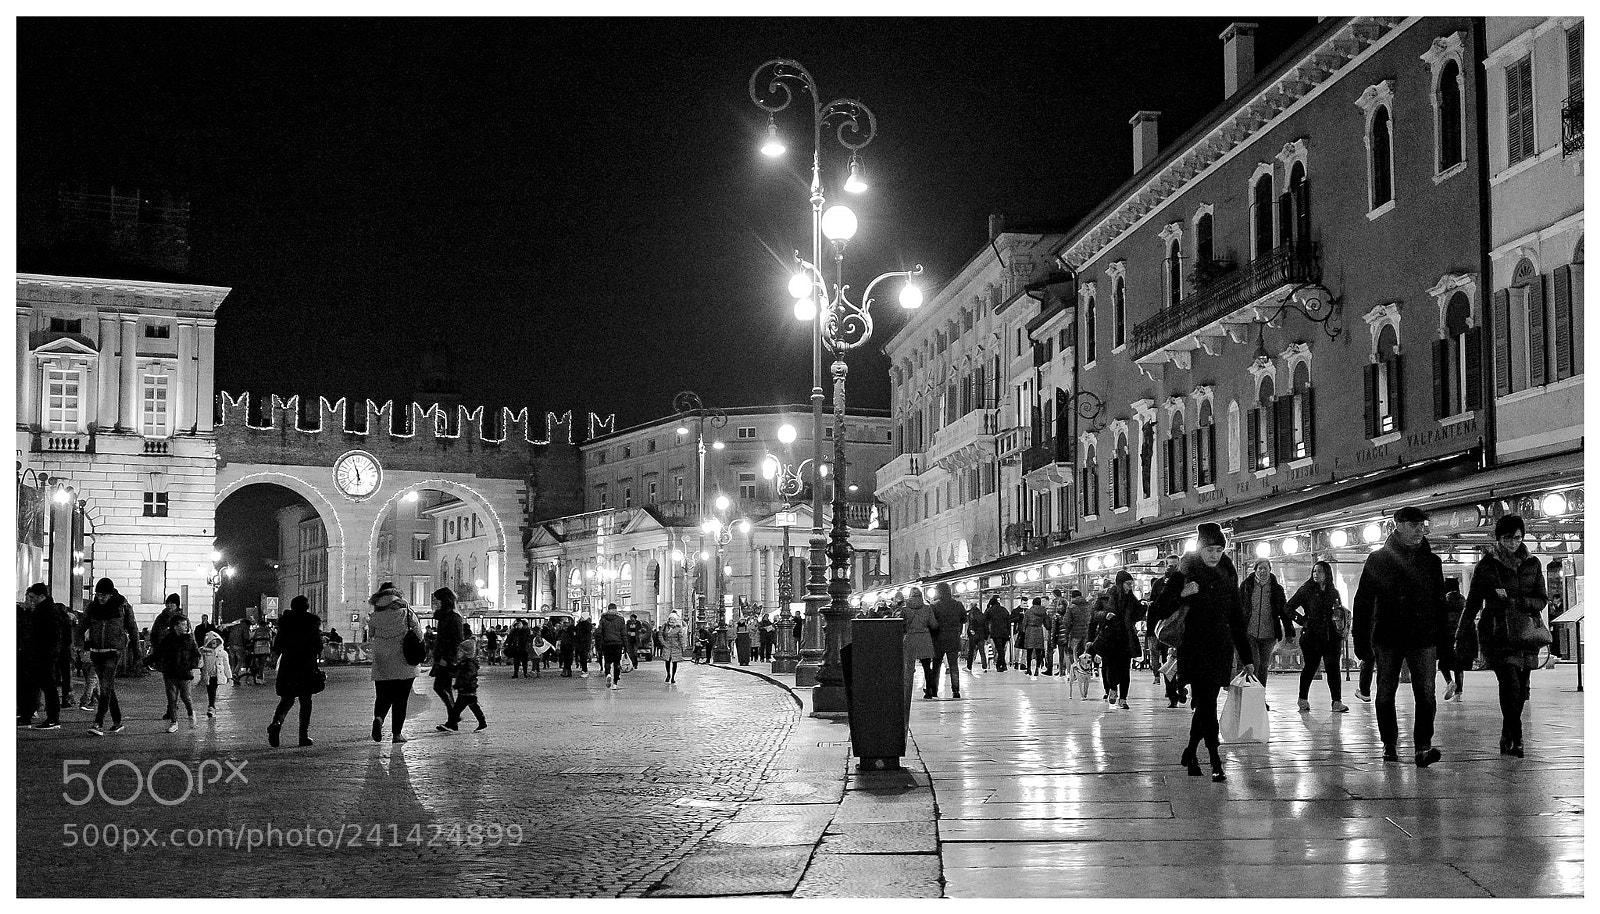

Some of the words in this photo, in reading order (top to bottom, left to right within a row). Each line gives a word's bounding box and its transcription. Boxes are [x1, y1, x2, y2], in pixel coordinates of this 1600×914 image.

[1236, 481, 1249, 494] PER
[1407, 417, 1478, 447] VALPANTENA
[352, 614, 359, 622] P
